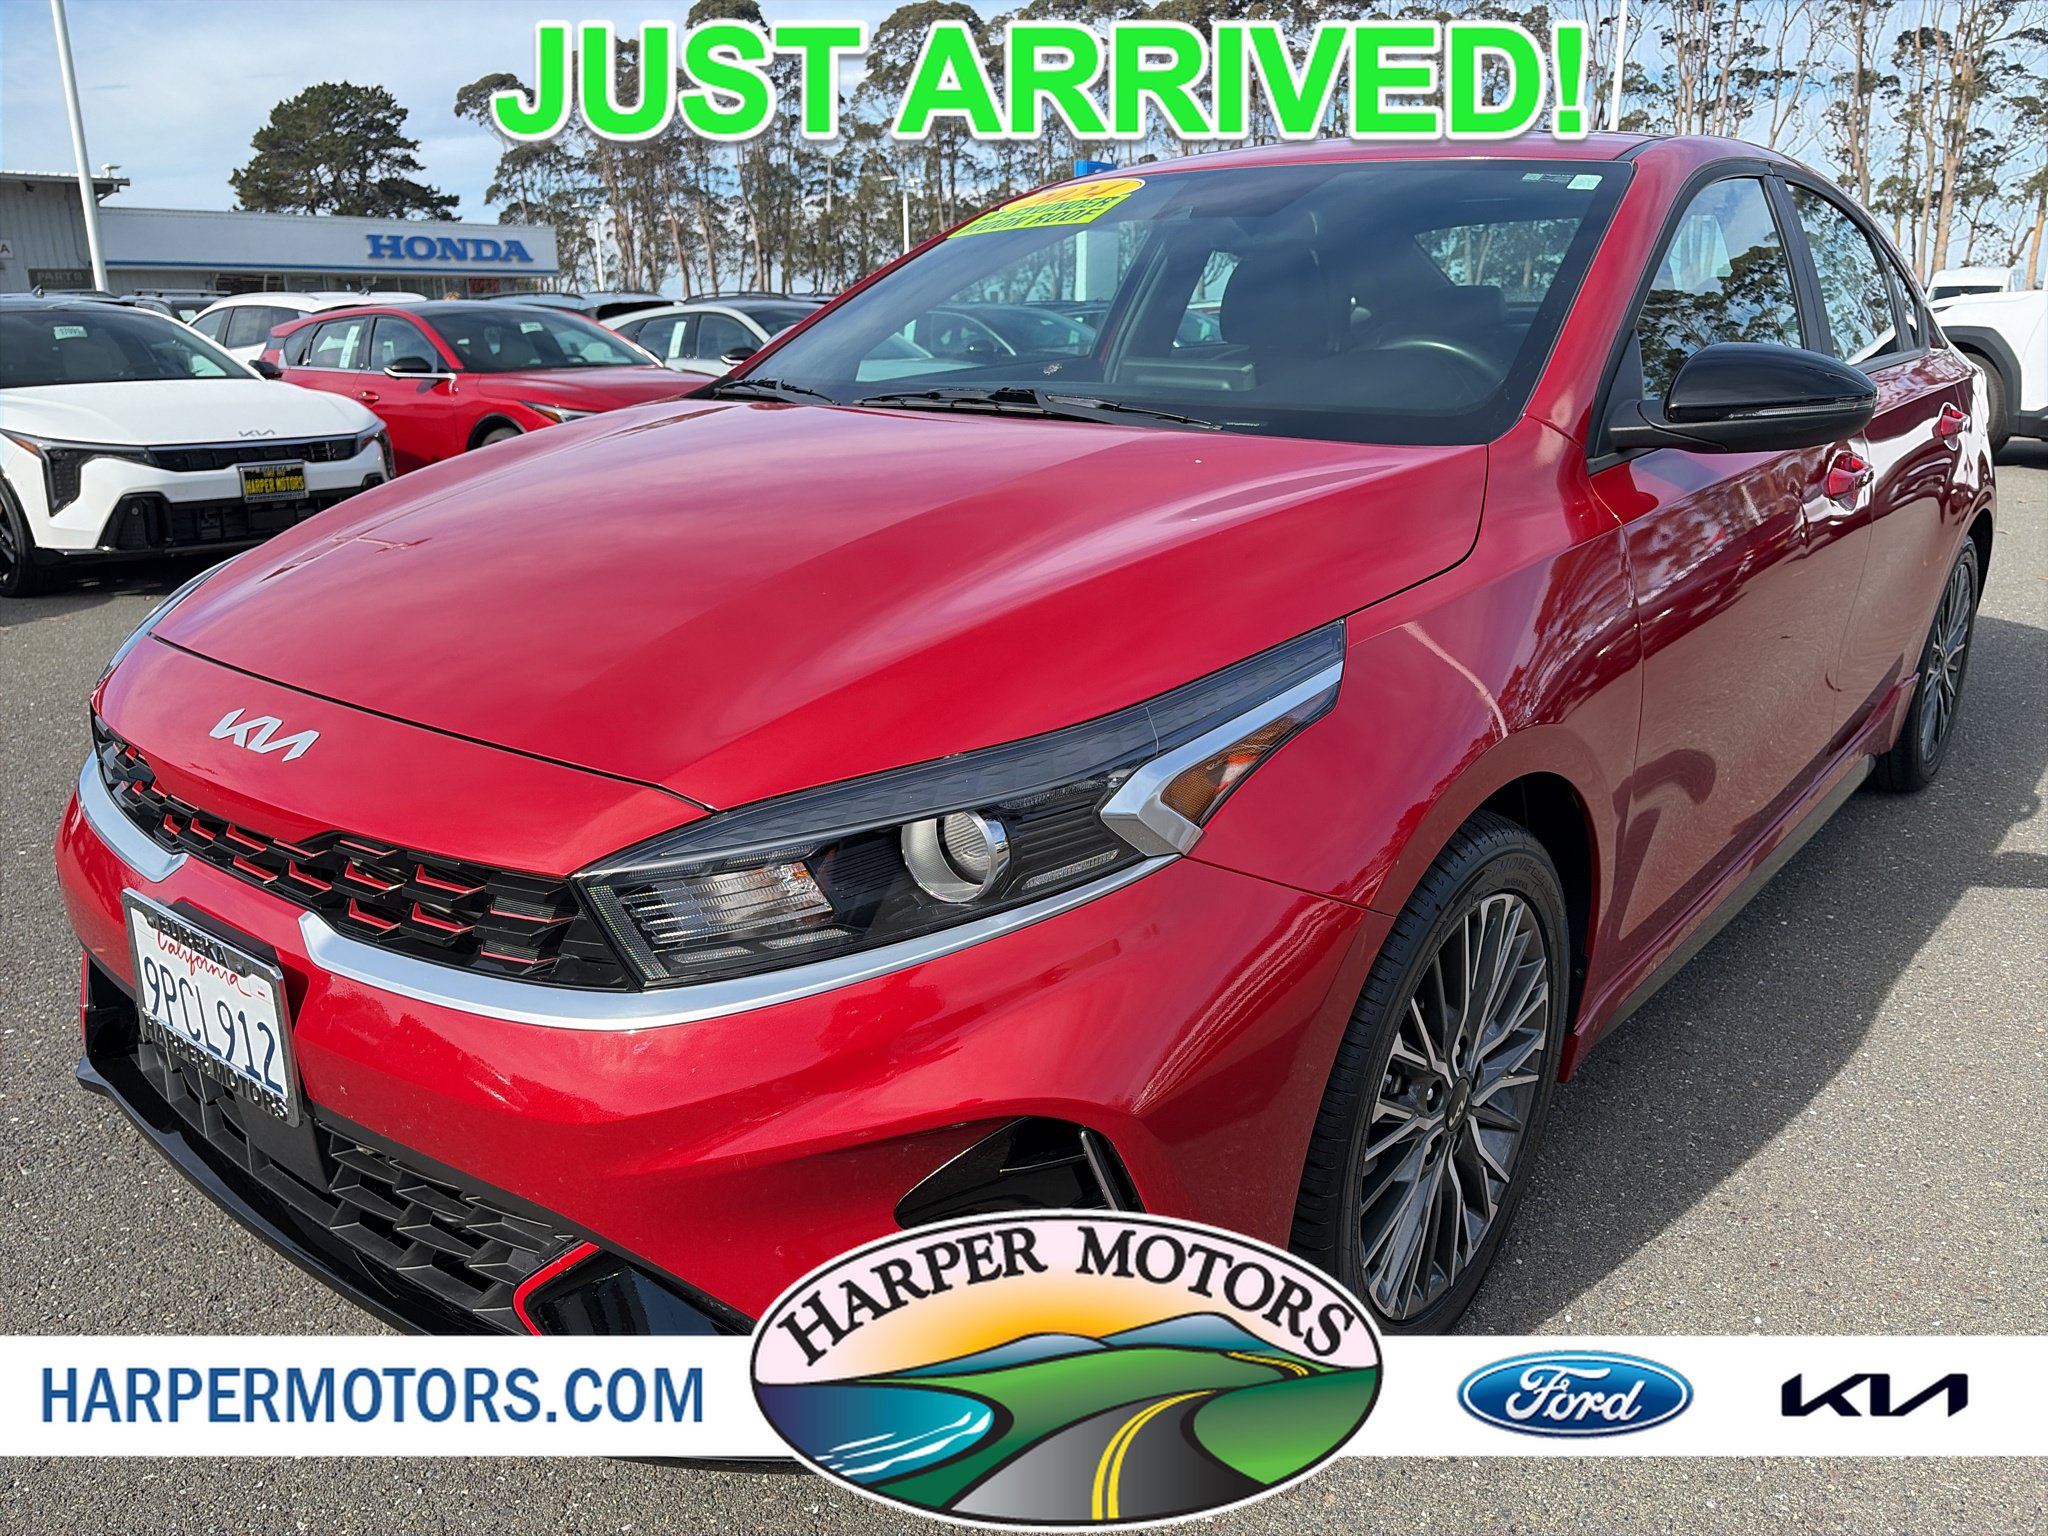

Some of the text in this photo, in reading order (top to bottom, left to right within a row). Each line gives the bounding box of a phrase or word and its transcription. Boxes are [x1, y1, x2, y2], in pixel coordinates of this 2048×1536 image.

[1024, 208, 1096, 226] ROOF
[366, 234, 534, 263] HONDA
[37, 271, 83, 281] PARTS
[245, 475, 305, 495] HARPER MOTORS
[209, 708, 320, 762] KIA
[157, 929, 252, 998] California
[158, 914, 230, 969] EUREKA
[143, 956, 285, 1095] 9PCL912
[145, 1018, 290, 1122] HARPER MOTORS
